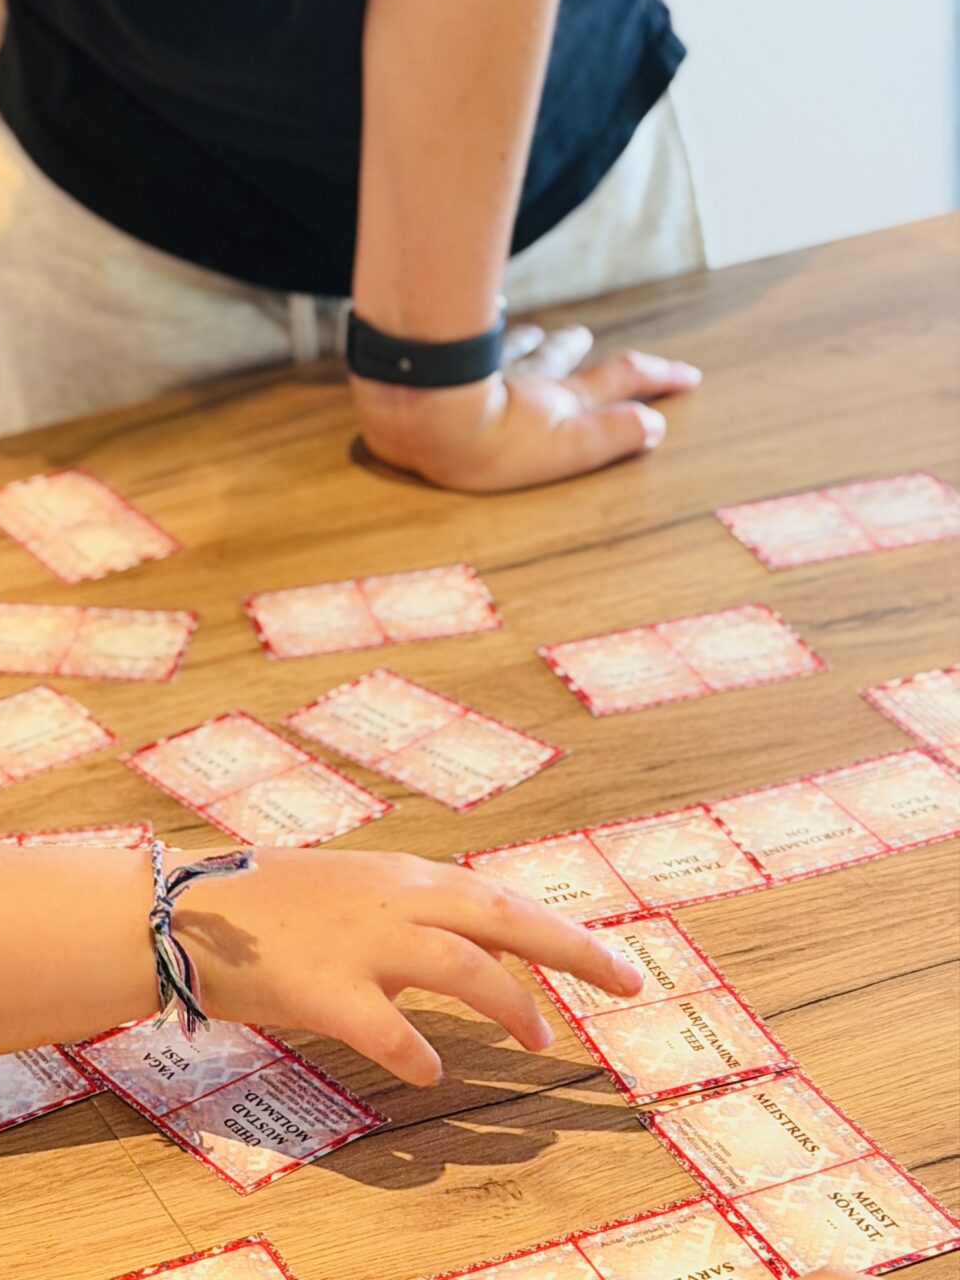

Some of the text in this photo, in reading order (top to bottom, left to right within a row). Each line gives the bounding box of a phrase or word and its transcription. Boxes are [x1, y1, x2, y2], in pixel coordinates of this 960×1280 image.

[544, 881, 571, 893] ON
[678, 1002, 741, 1069] HARJUTAMINE
[679, 1028, 705, 1052] TEEB
[142, 1051, 176, 1080] VAGA
[224, 1117, 262, 1148] ÜHED
[232, 1103, 289, 1146] MUSTAD
[752, 1092, 821, 1157] MEISTRIKS.
[851, 1190, 899, 1230] MEEST
